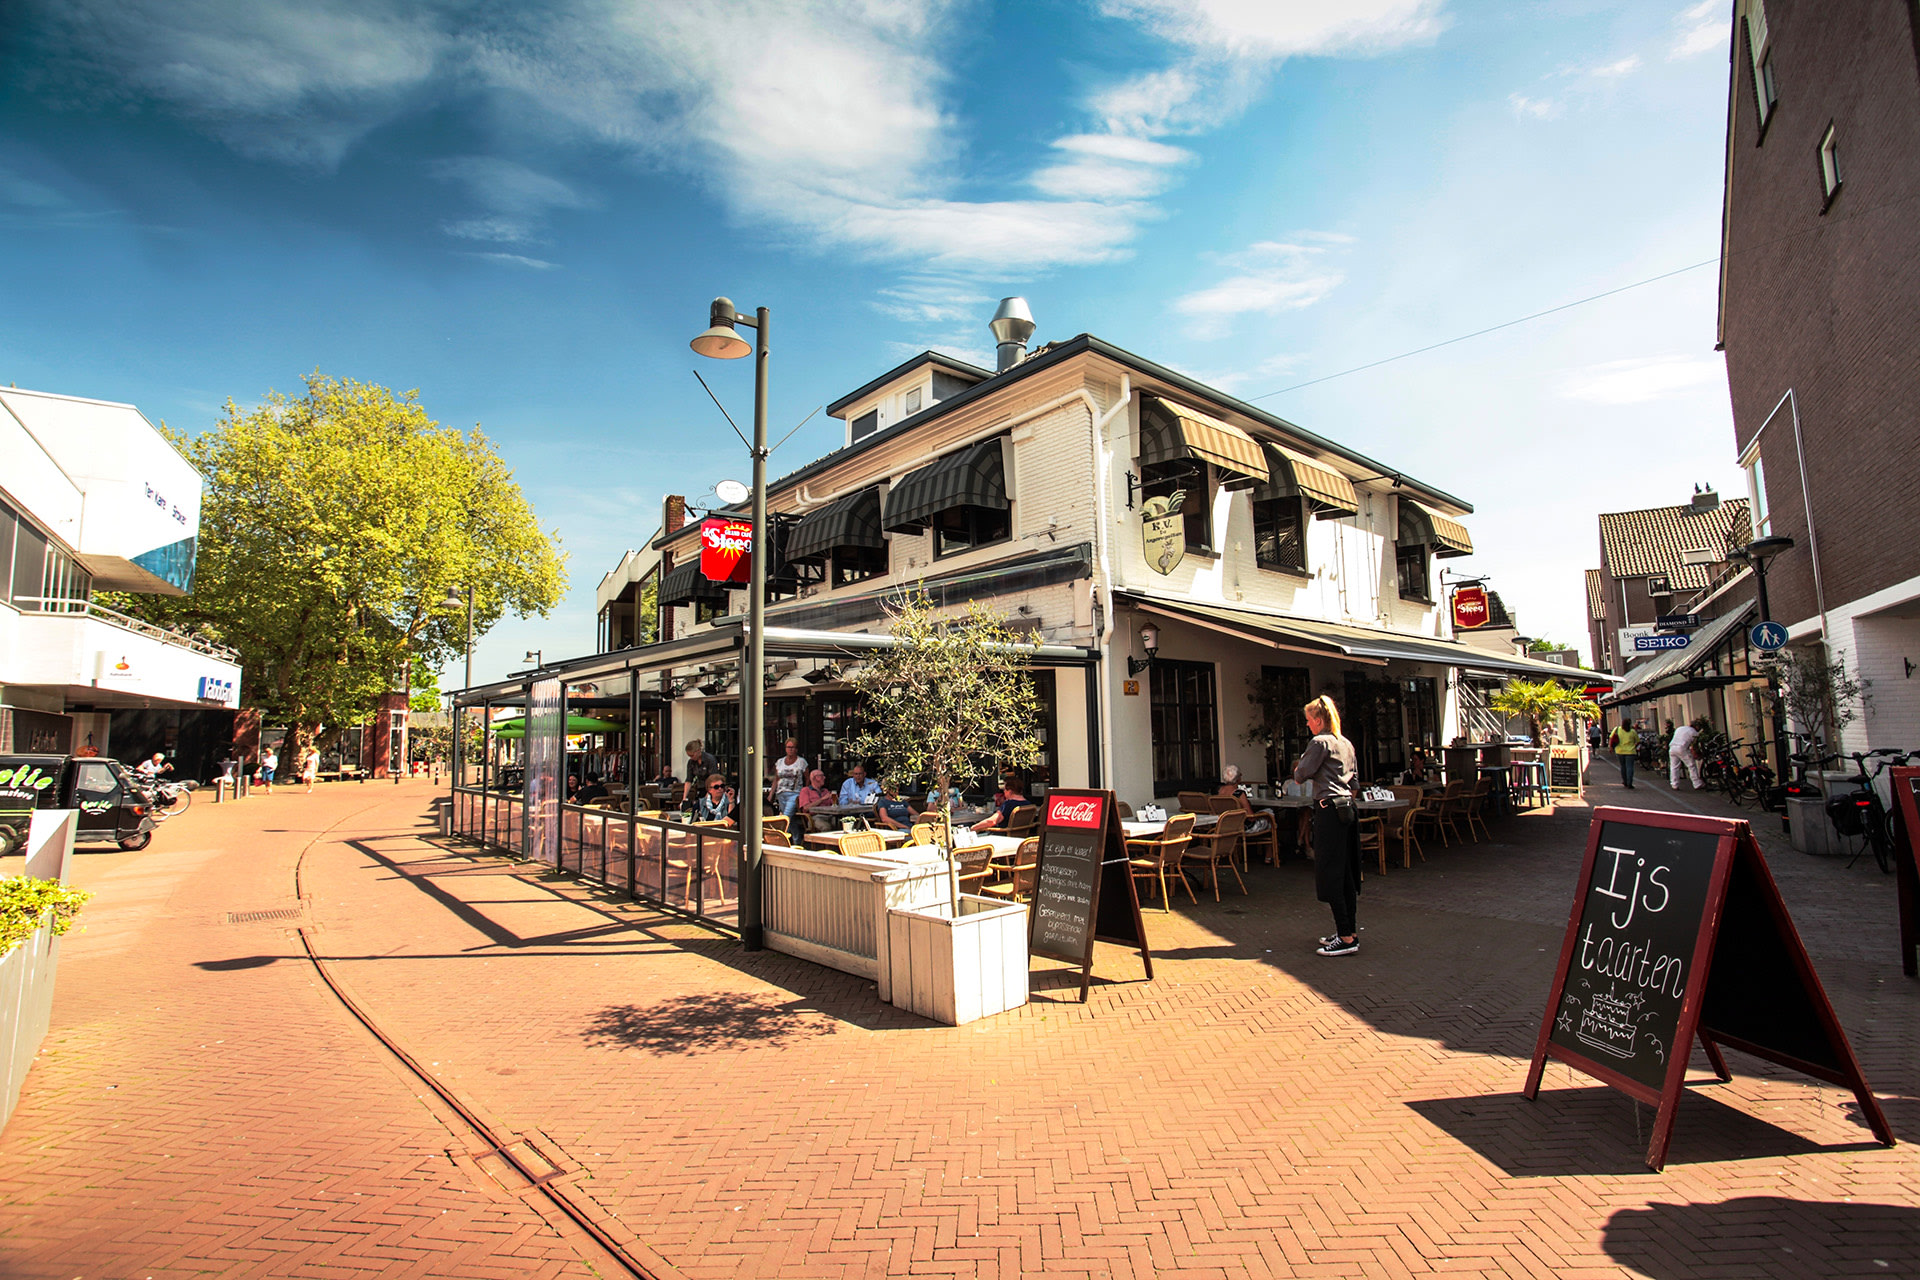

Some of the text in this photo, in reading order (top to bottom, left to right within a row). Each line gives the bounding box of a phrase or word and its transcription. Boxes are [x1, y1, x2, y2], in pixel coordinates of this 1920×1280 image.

[1636, 636, 1688, 649] SEIKO
[1052, 801, 1097, 822] Coca-Cola
[1595, 845, 1670, 929] Ijs
[1581, 923, 1683, 999] taarten
